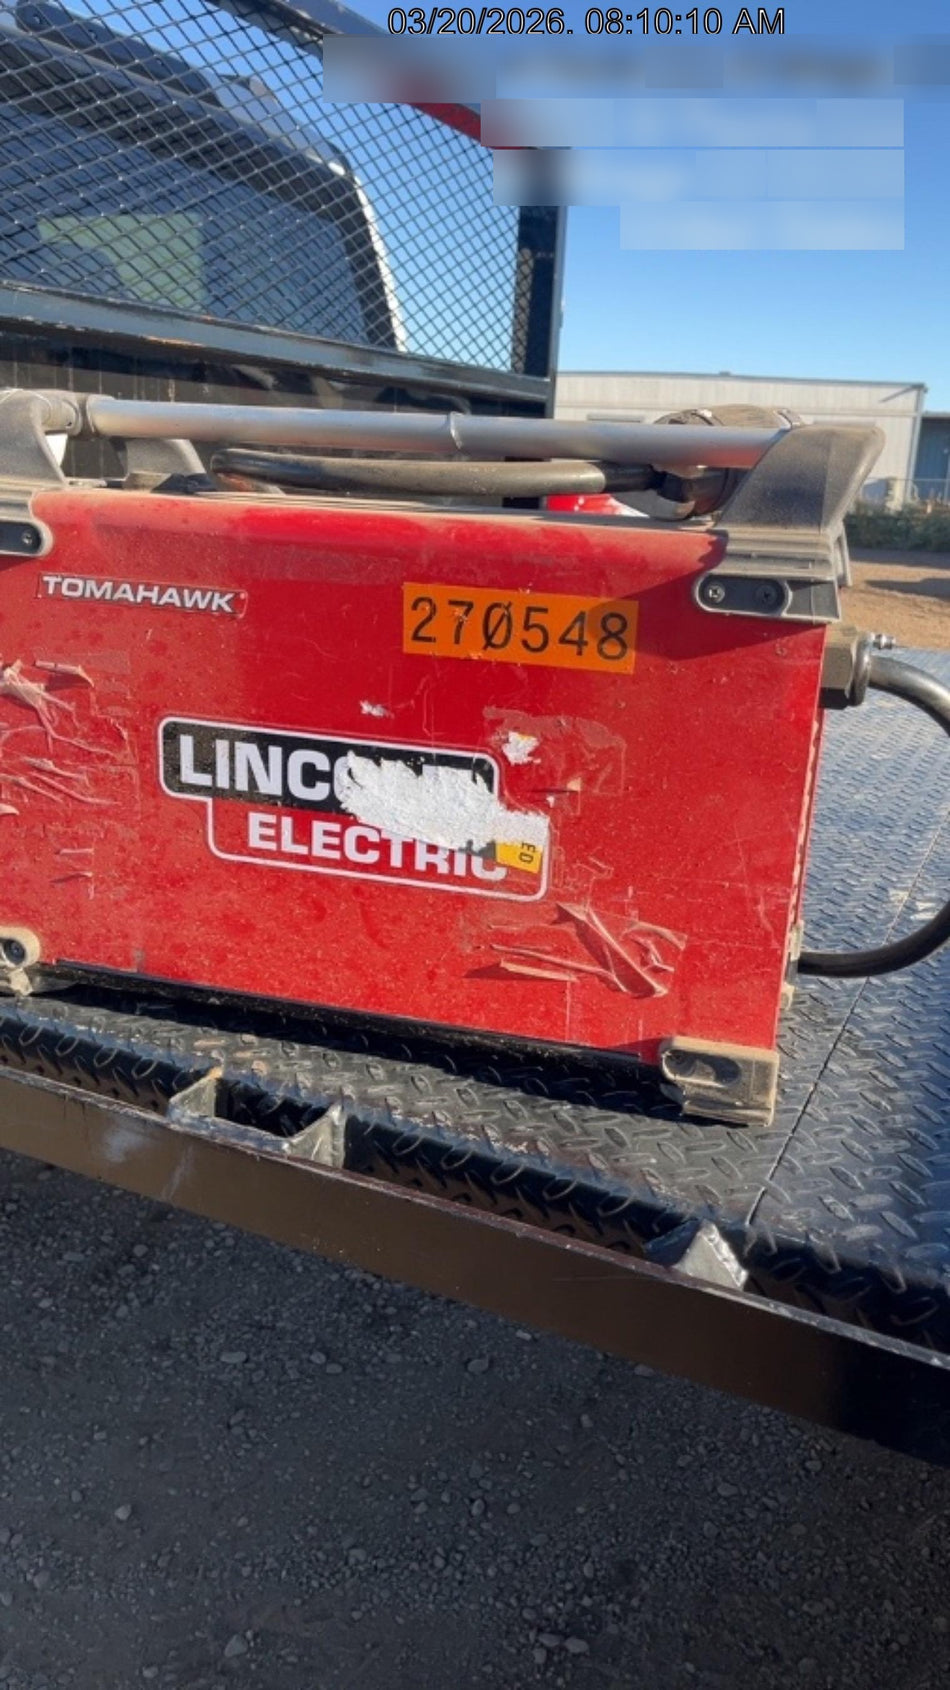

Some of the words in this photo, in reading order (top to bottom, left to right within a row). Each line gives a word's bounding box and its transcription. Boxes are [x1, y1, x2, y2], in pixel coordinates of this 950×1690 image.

[42, 575, 235, 613] TOMAHAWK
[410, 596, 630, 661] 270548
[178, 734, 474, 814] LINC
